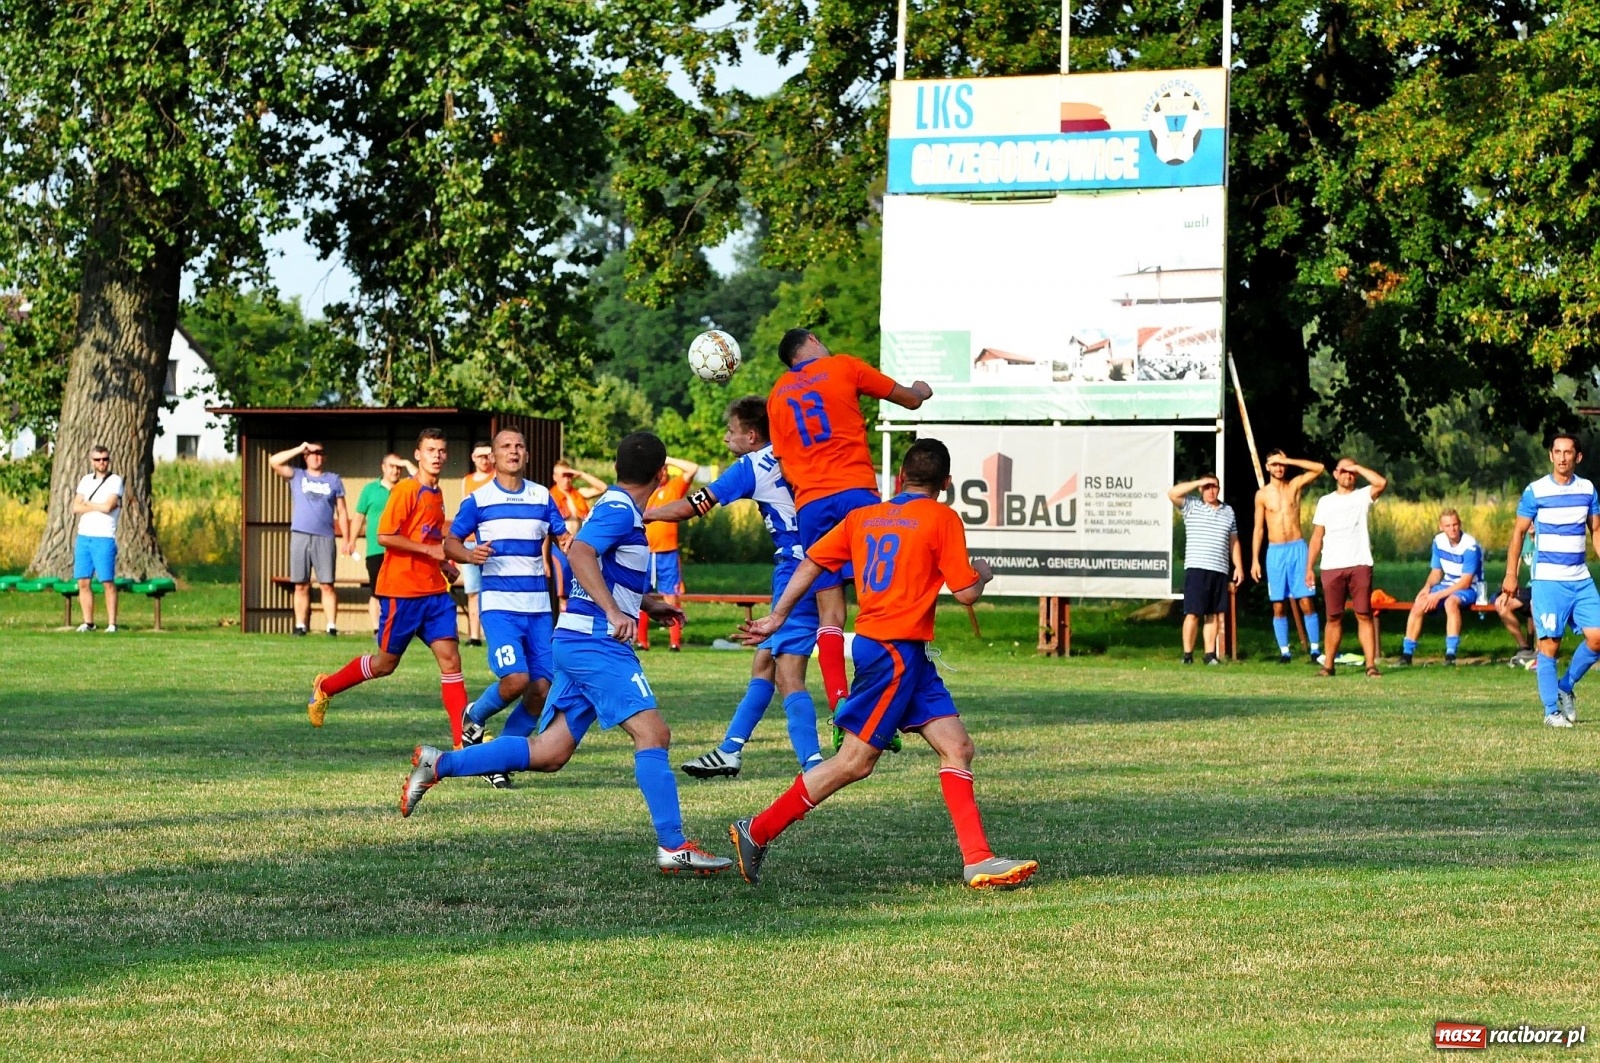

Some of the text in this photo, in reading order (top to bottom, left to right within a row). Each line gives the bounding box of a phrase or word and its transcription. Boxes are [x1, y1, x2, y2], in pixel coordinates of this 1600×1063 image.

[916, 84, 973, 130] LKS
[911, 138, 1139, 185] GRZEGORZOWICE
[786, 390, 832, 448] 13
[758, 451, 778, 473] LK
[1084, 476, 1133, 489] RS BAU
[692, 491, 706, 504] C
[1006, 494, 1077, 527] BAU
[863, 533, 900, 593] 18
[1047, 557, 1168, 571] GENERALUNTERNEHMER
[1540, 613, 1557, 632] 14
[495, 644, 517, 668] 13
